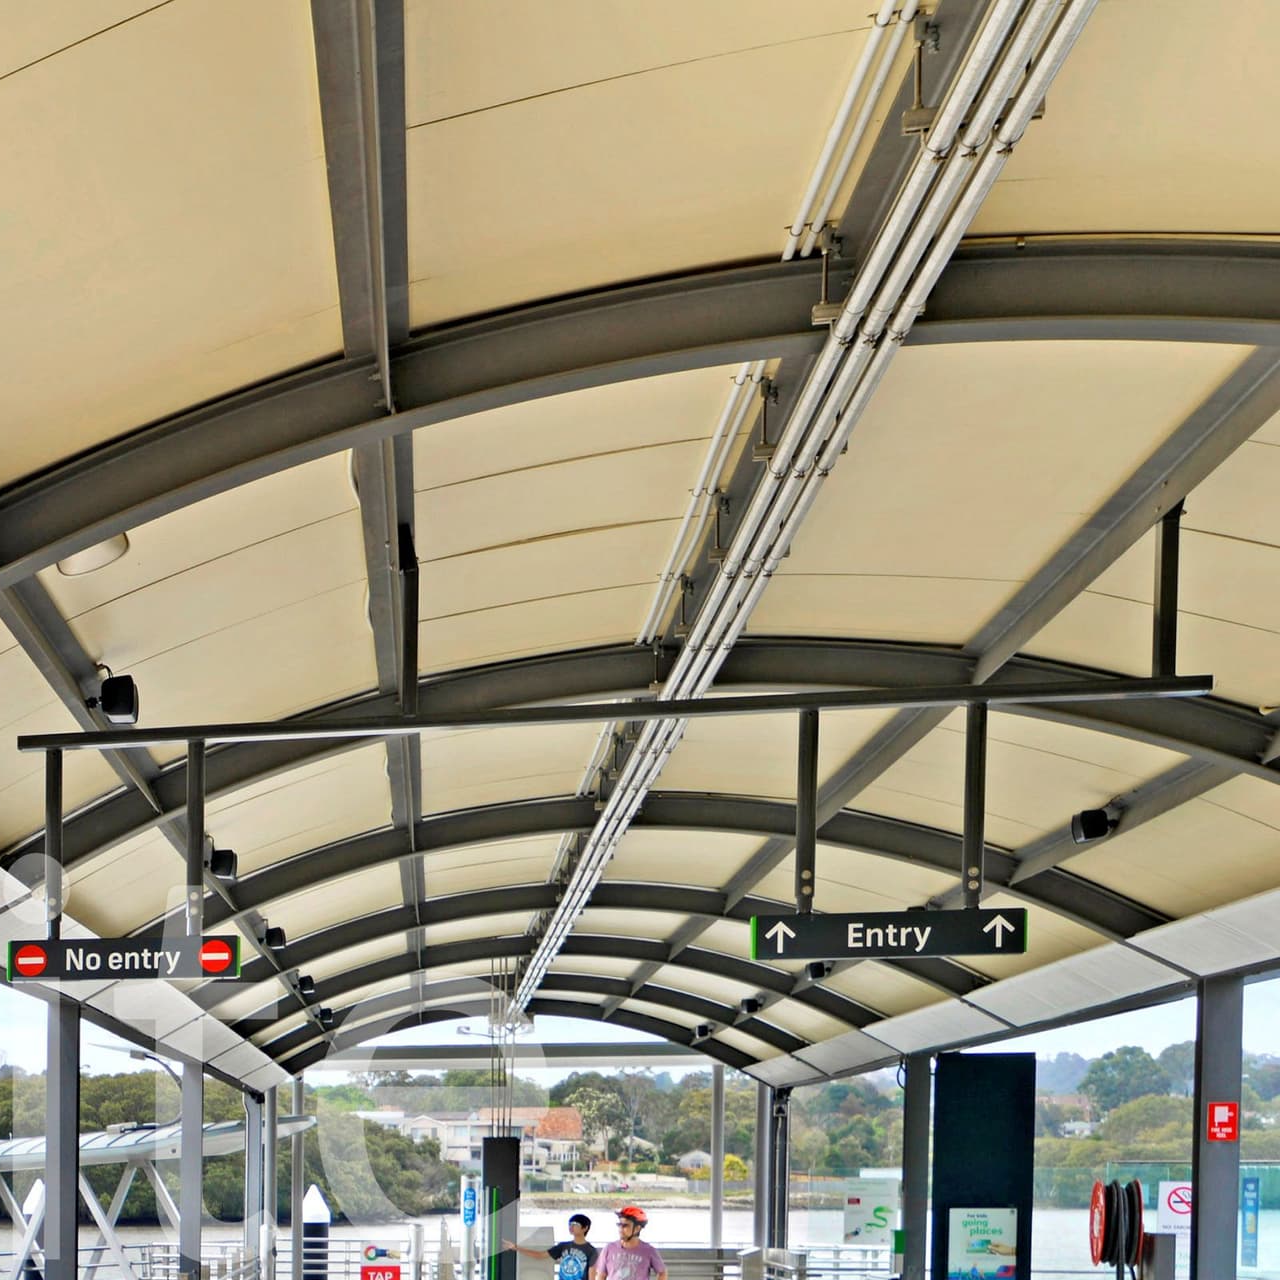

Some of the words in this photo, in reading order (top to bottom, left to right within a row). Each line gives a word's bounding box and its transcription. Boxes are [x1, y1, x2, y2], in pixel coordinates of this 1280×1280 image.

[847, 923, 932, 952] Entry
[65, 948, 101, 972] No
[107, 948, 181, 975] entry
